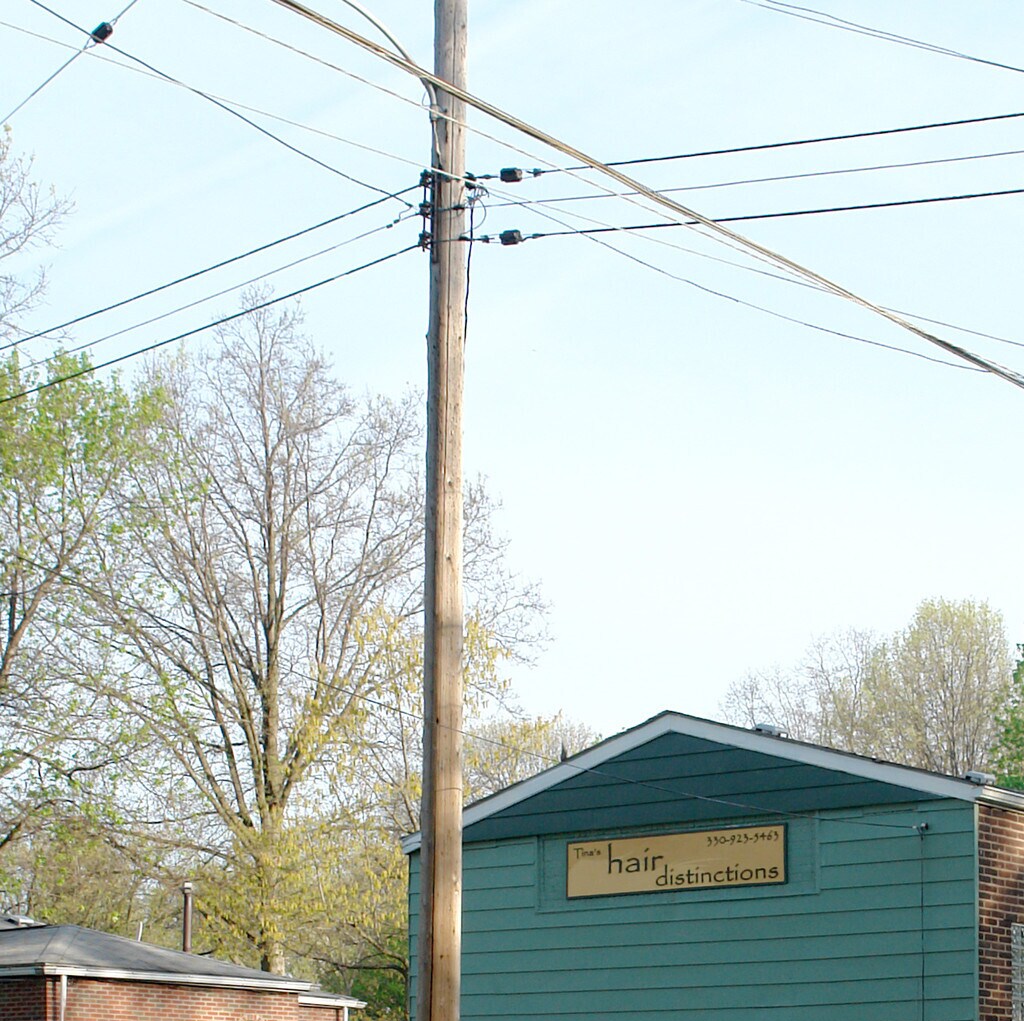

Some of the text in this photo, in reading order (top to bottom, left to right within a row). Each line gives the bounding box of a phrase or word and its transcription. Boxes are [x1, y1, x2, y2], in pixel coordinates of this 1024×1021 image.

[573, 847, 602, 859] Tina's
[608, 843, 664, 874] hair
[655, 863, 779, 886] distinctions
